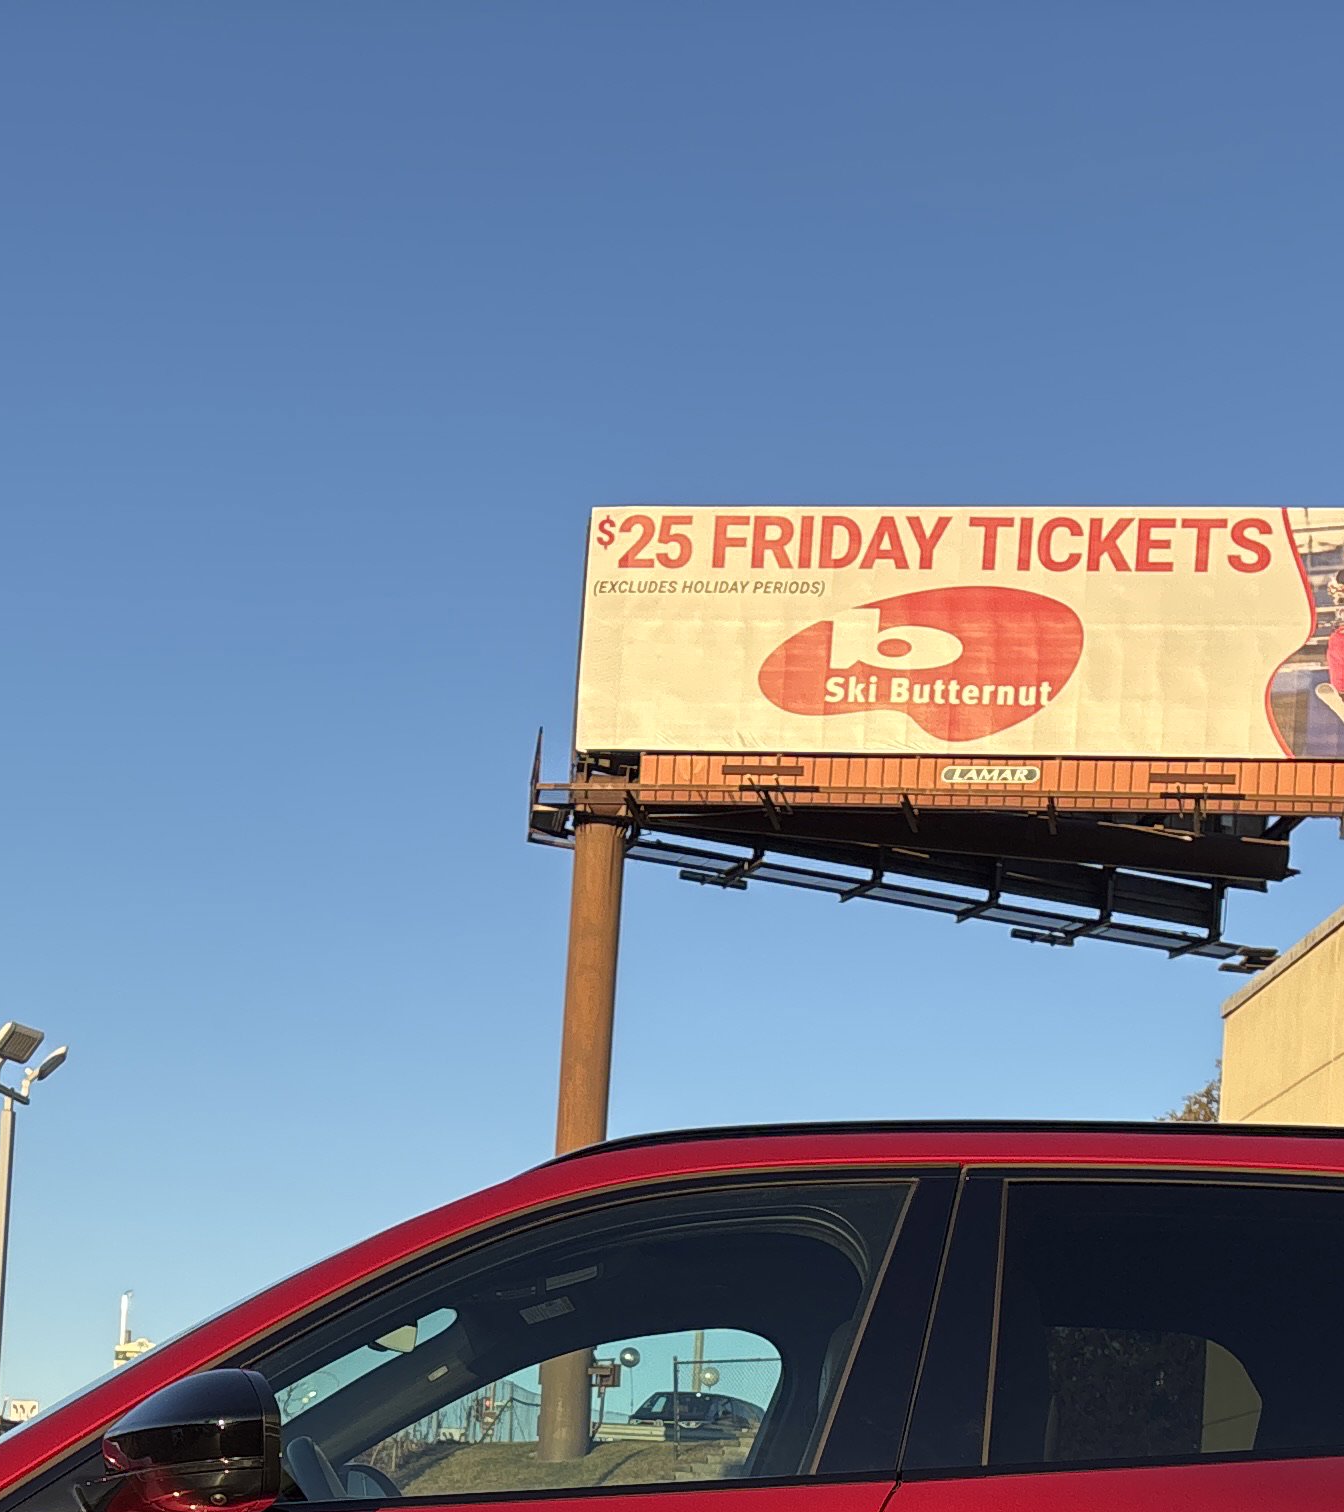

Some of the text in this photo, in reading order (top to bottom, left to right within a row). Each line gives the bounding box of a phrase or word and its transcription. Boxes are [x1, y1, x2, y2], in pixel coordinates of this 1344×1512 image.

[596, 514, 1273, 573] $25 FRIDAY TICKETS
[593, 581, 826, 598] (EXCLUDES HOLIDAY PERIODS)
[825, 676, 1053, 707] Ski Butternut
[954, 767, 1030, 783] LAMAR
